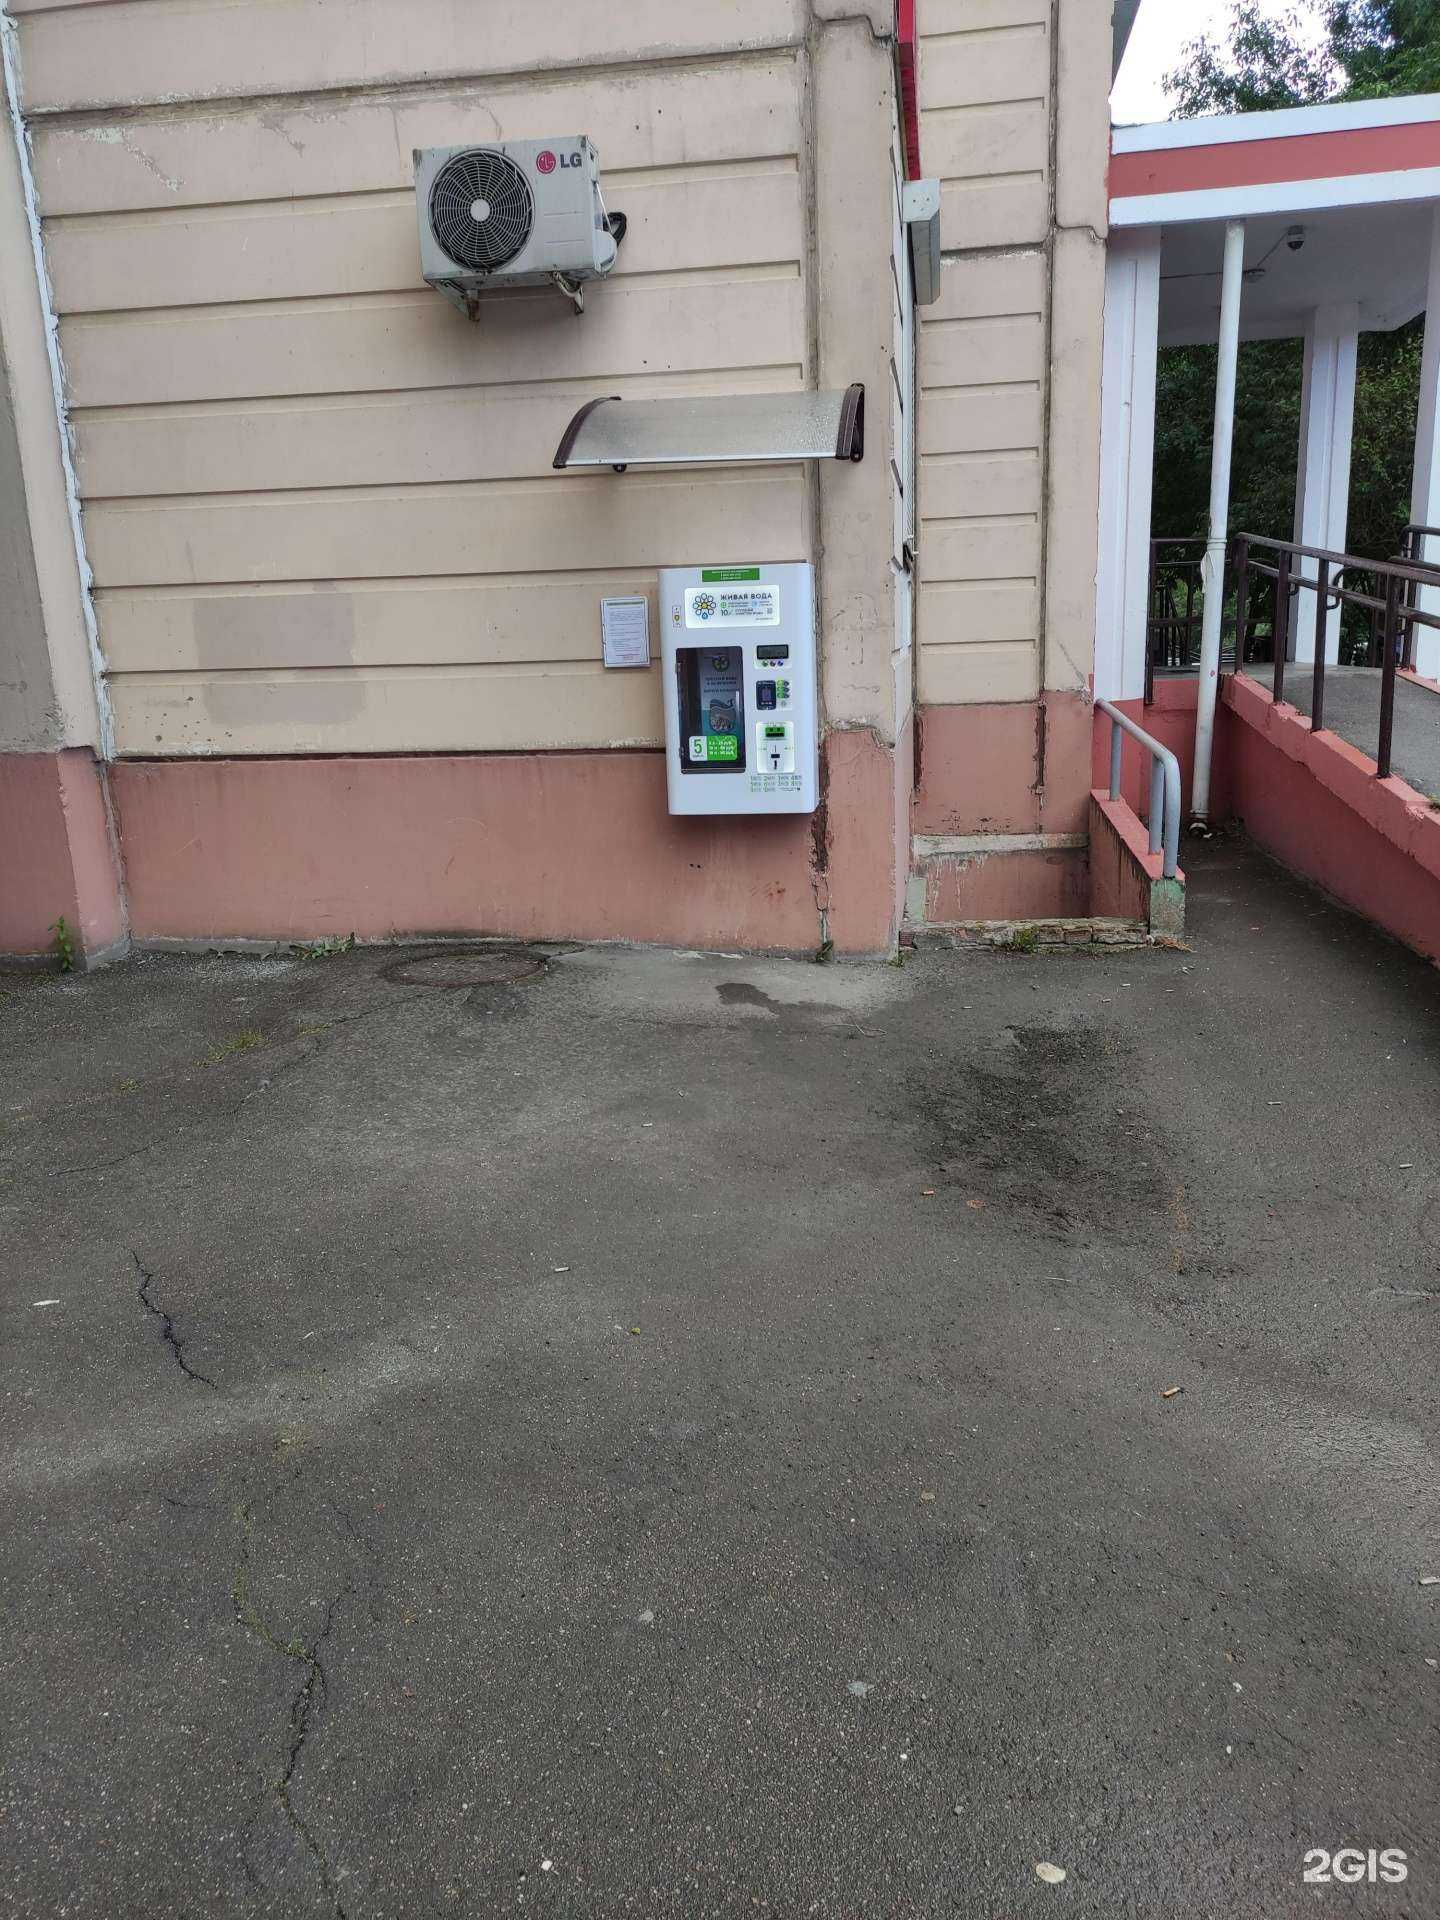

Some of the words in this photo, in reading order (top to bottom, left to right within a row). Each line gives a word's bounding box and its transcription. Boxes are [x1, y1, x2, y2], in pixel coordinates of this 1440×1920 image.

[560, 152, 582, 168] LG
[750, 592, 773, 600] ВОДА
[694, 738, 702, 754] 5
